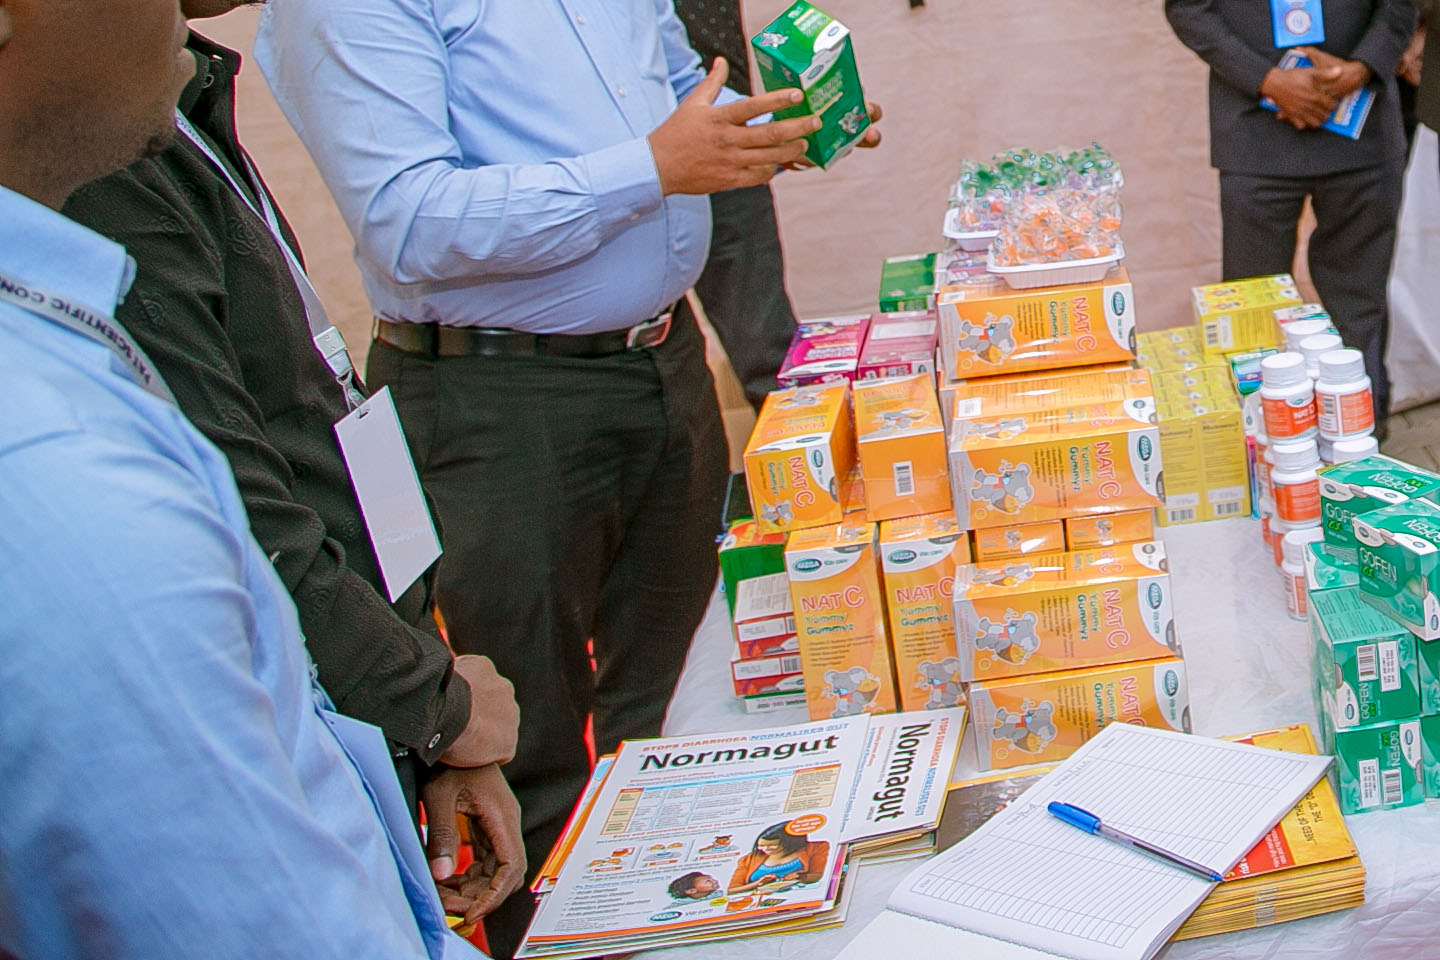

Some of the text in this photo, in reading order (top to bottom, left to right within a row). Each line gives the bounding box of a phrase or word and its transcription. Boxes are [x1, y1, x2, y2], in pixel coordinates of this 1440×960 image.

[51, 298, 134, 359] SCIENTIFIC
[1072, 296, 1096, 353] NAT C
[788, 455, 816, 508] NAT C
[1093, 440, 1122, 500] NAT C
[1367, 472, 1419, 494] GOFEN
[1359, 547, 1398, 583] GOFEN
[801, 585, 865, 612] NAT C
[895, 583, 936, 604] NAT
[1089, 593, 1100, 633] Yummy
[1103, 588, 1131, 649] NAT C
[1119, 676, 1140, 718] NAT
[1358, 682, 1371, 720] GOFEN
[641, 743, 680, 753] STOPS
[681, 736, 749, 749] DIARRHOEA
[825, 722, 850, 732] GUT
[937, 717, 949, 735] STOPS
[639, 734, 841, 772] Normagut
[929, 735, 945, 767] DIARRHOEA
[1389, 730, 1401, 768] GOFEN
[872, 723, 932, 823] Normagut
[1297, 817, 1310, 825] OF
[1311, 810, 1324, 823] THE
[652, 911, 680, 921] MEGA
